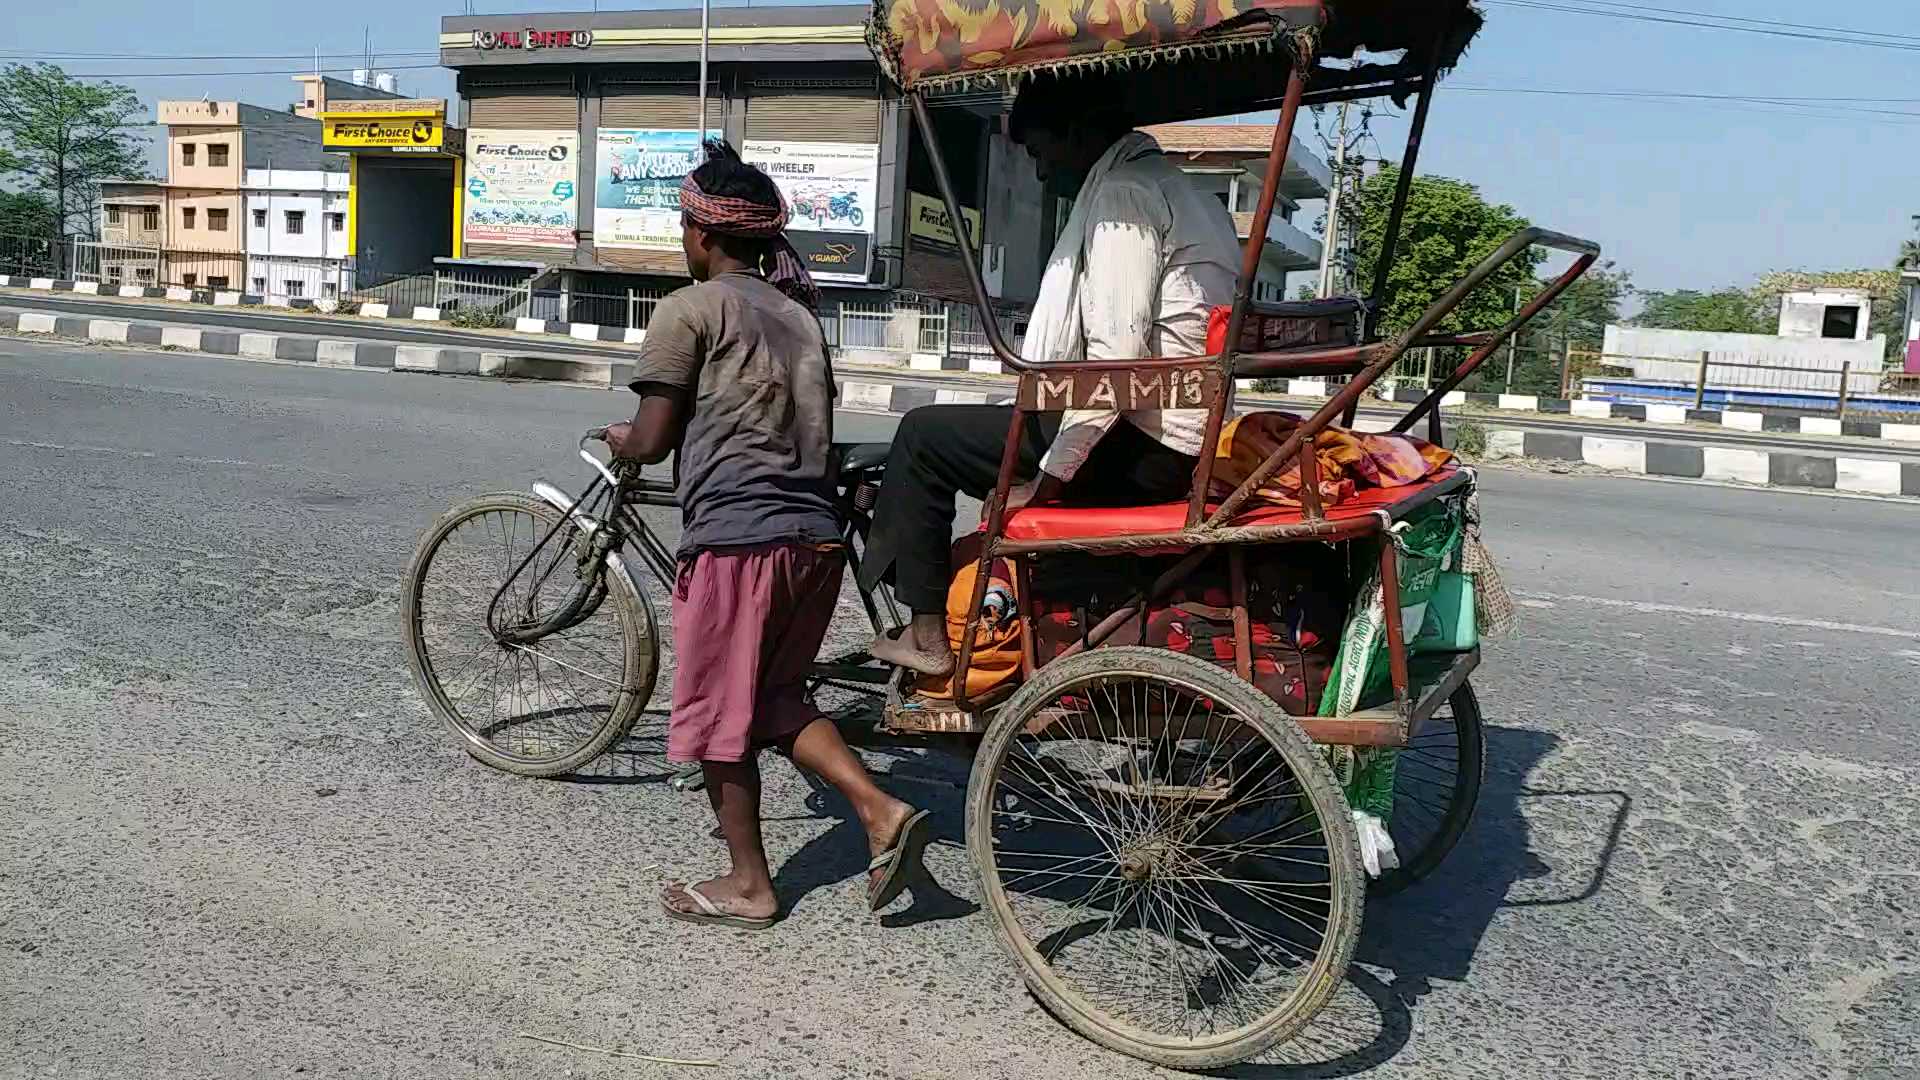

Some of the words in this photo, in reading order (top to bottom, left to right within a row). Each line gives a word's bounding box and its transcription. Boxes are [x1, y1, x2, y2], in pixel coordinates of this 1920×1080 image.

[473, 29, 522, 49] ROYAL
[525, 28, 592, 51] ENFIELD
[507, 145, 548, 157] Choice
[620, 163, 649, 181] ANY
[770, 163, 815, 174] WHEELER
[624, 195, 655, 205] THEM
